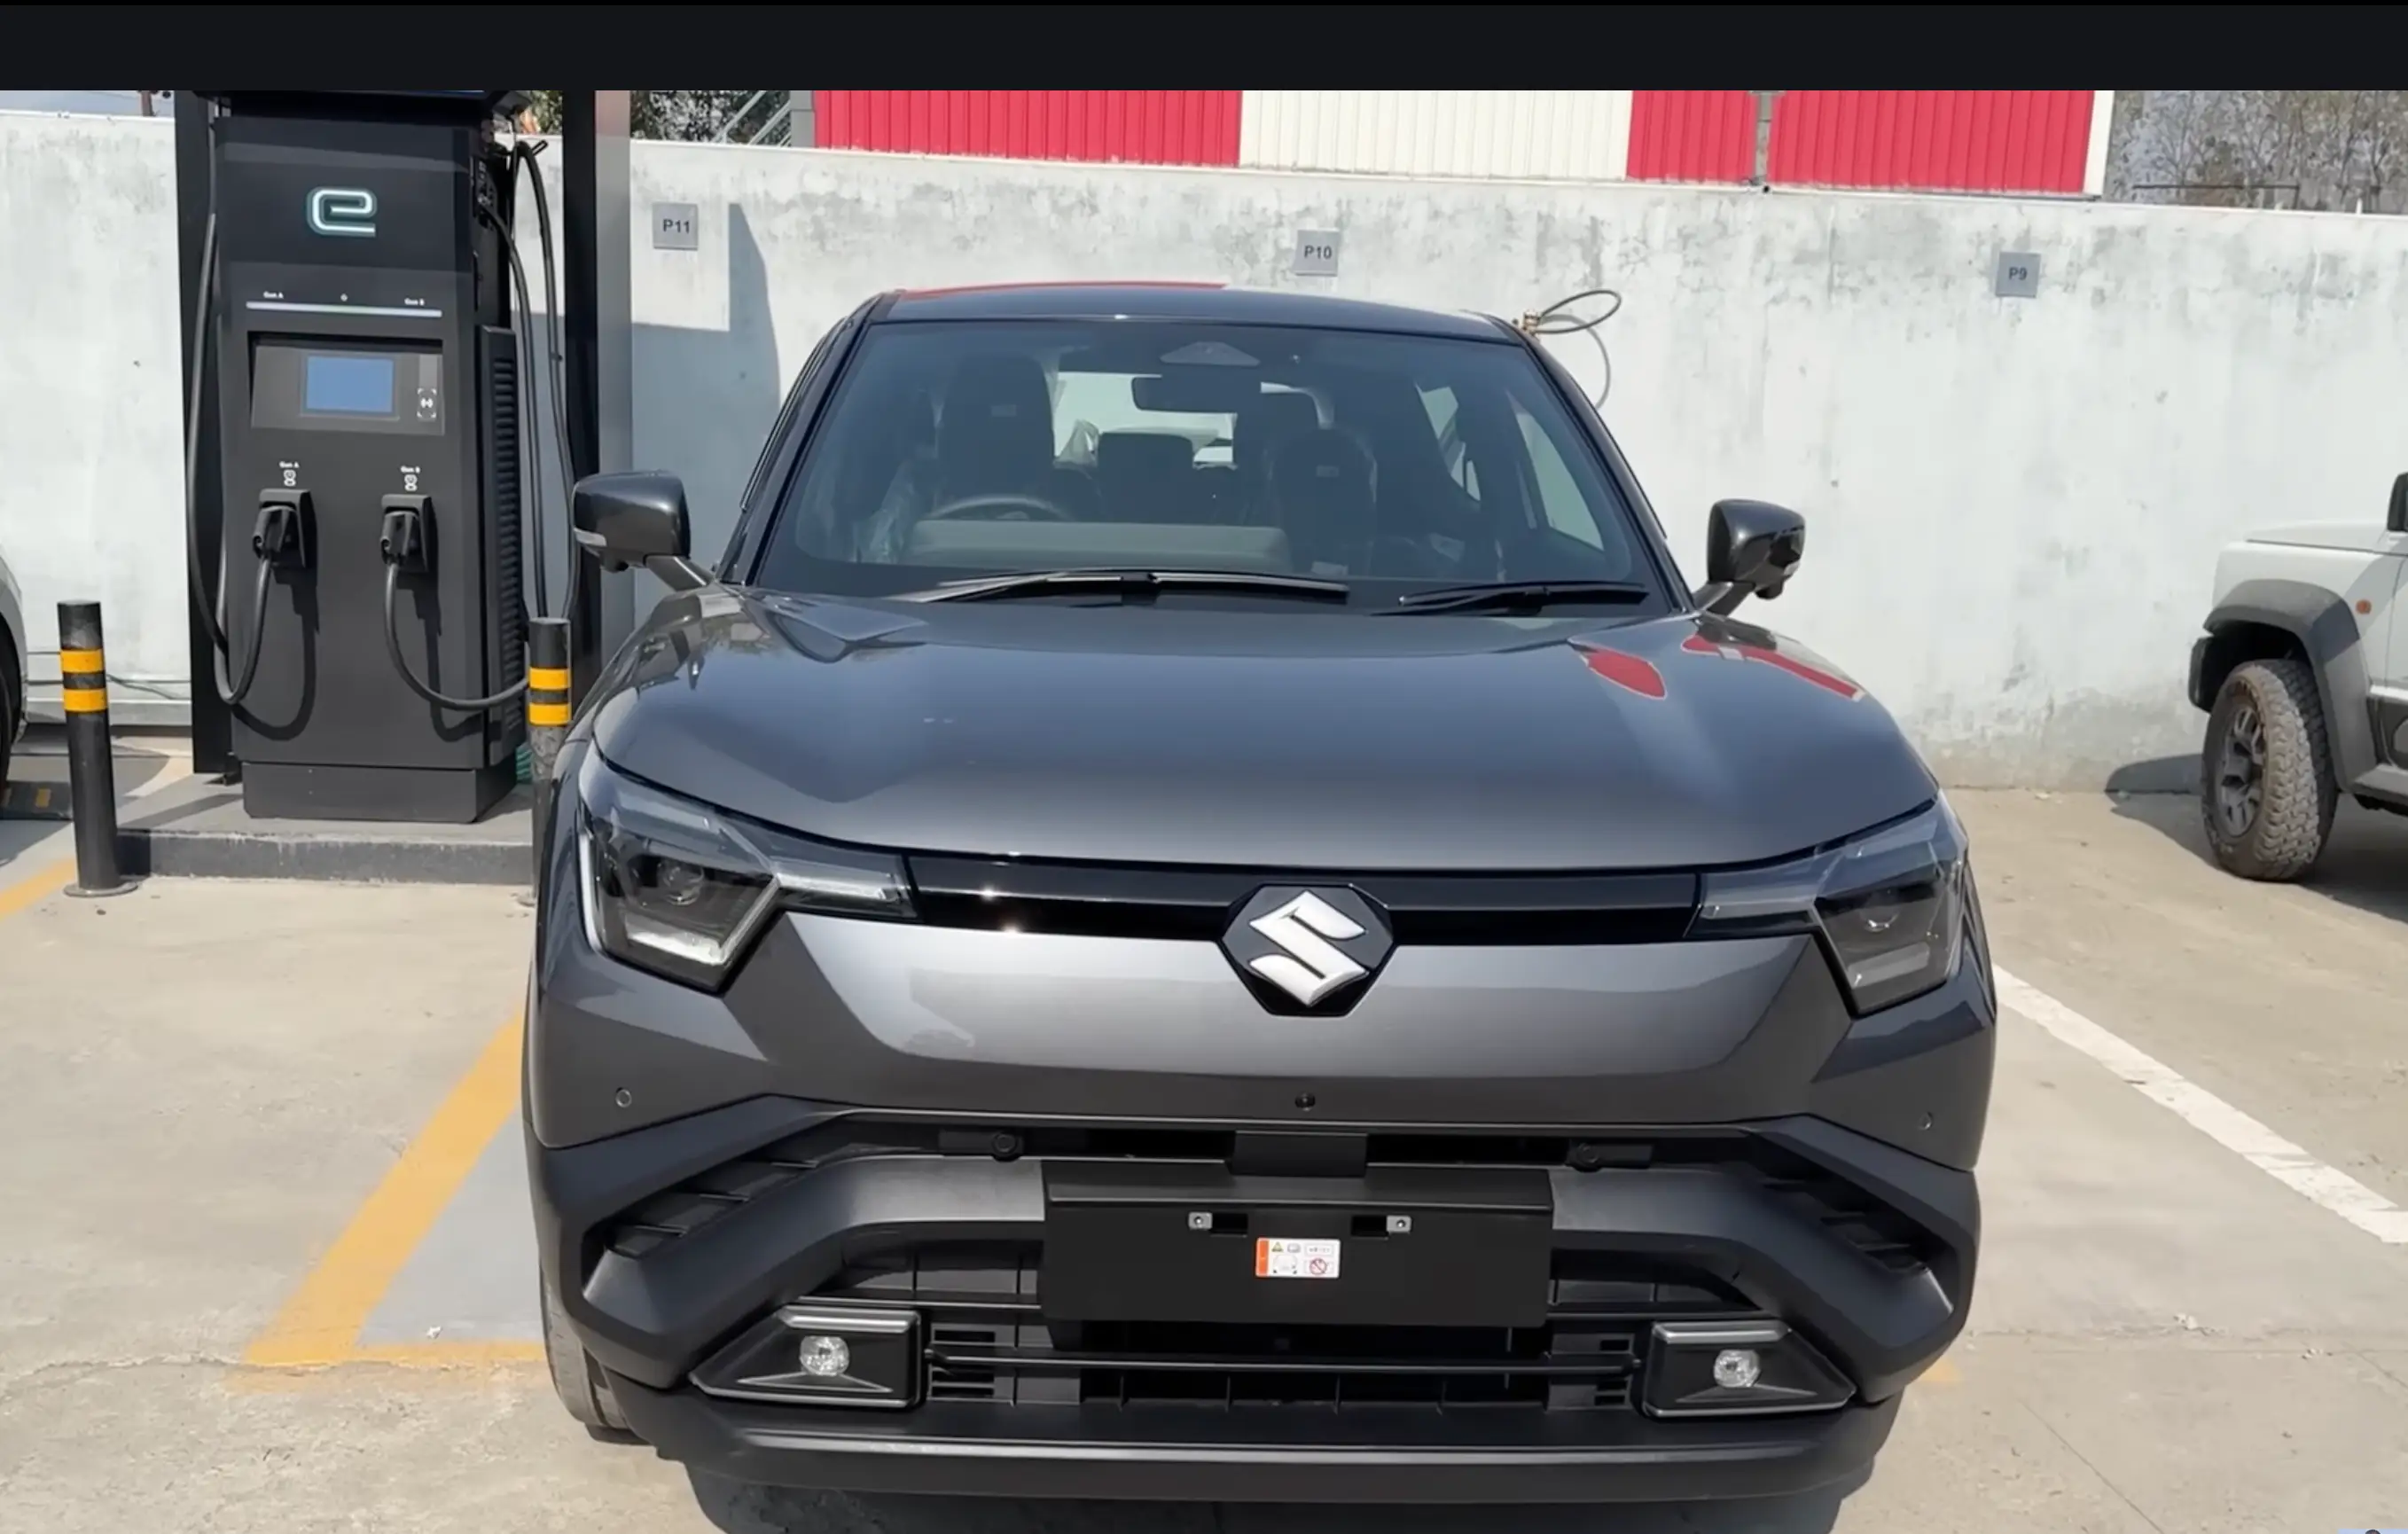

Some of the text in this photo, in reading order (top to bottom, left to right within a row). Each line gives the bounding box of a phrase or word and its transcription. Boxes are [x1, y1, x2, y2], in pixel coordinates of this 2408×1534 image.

[663, 218, 690, 234] P11
[1304, 245, 1332, 260] P10
[2009, 267, 2028, 280] P9
